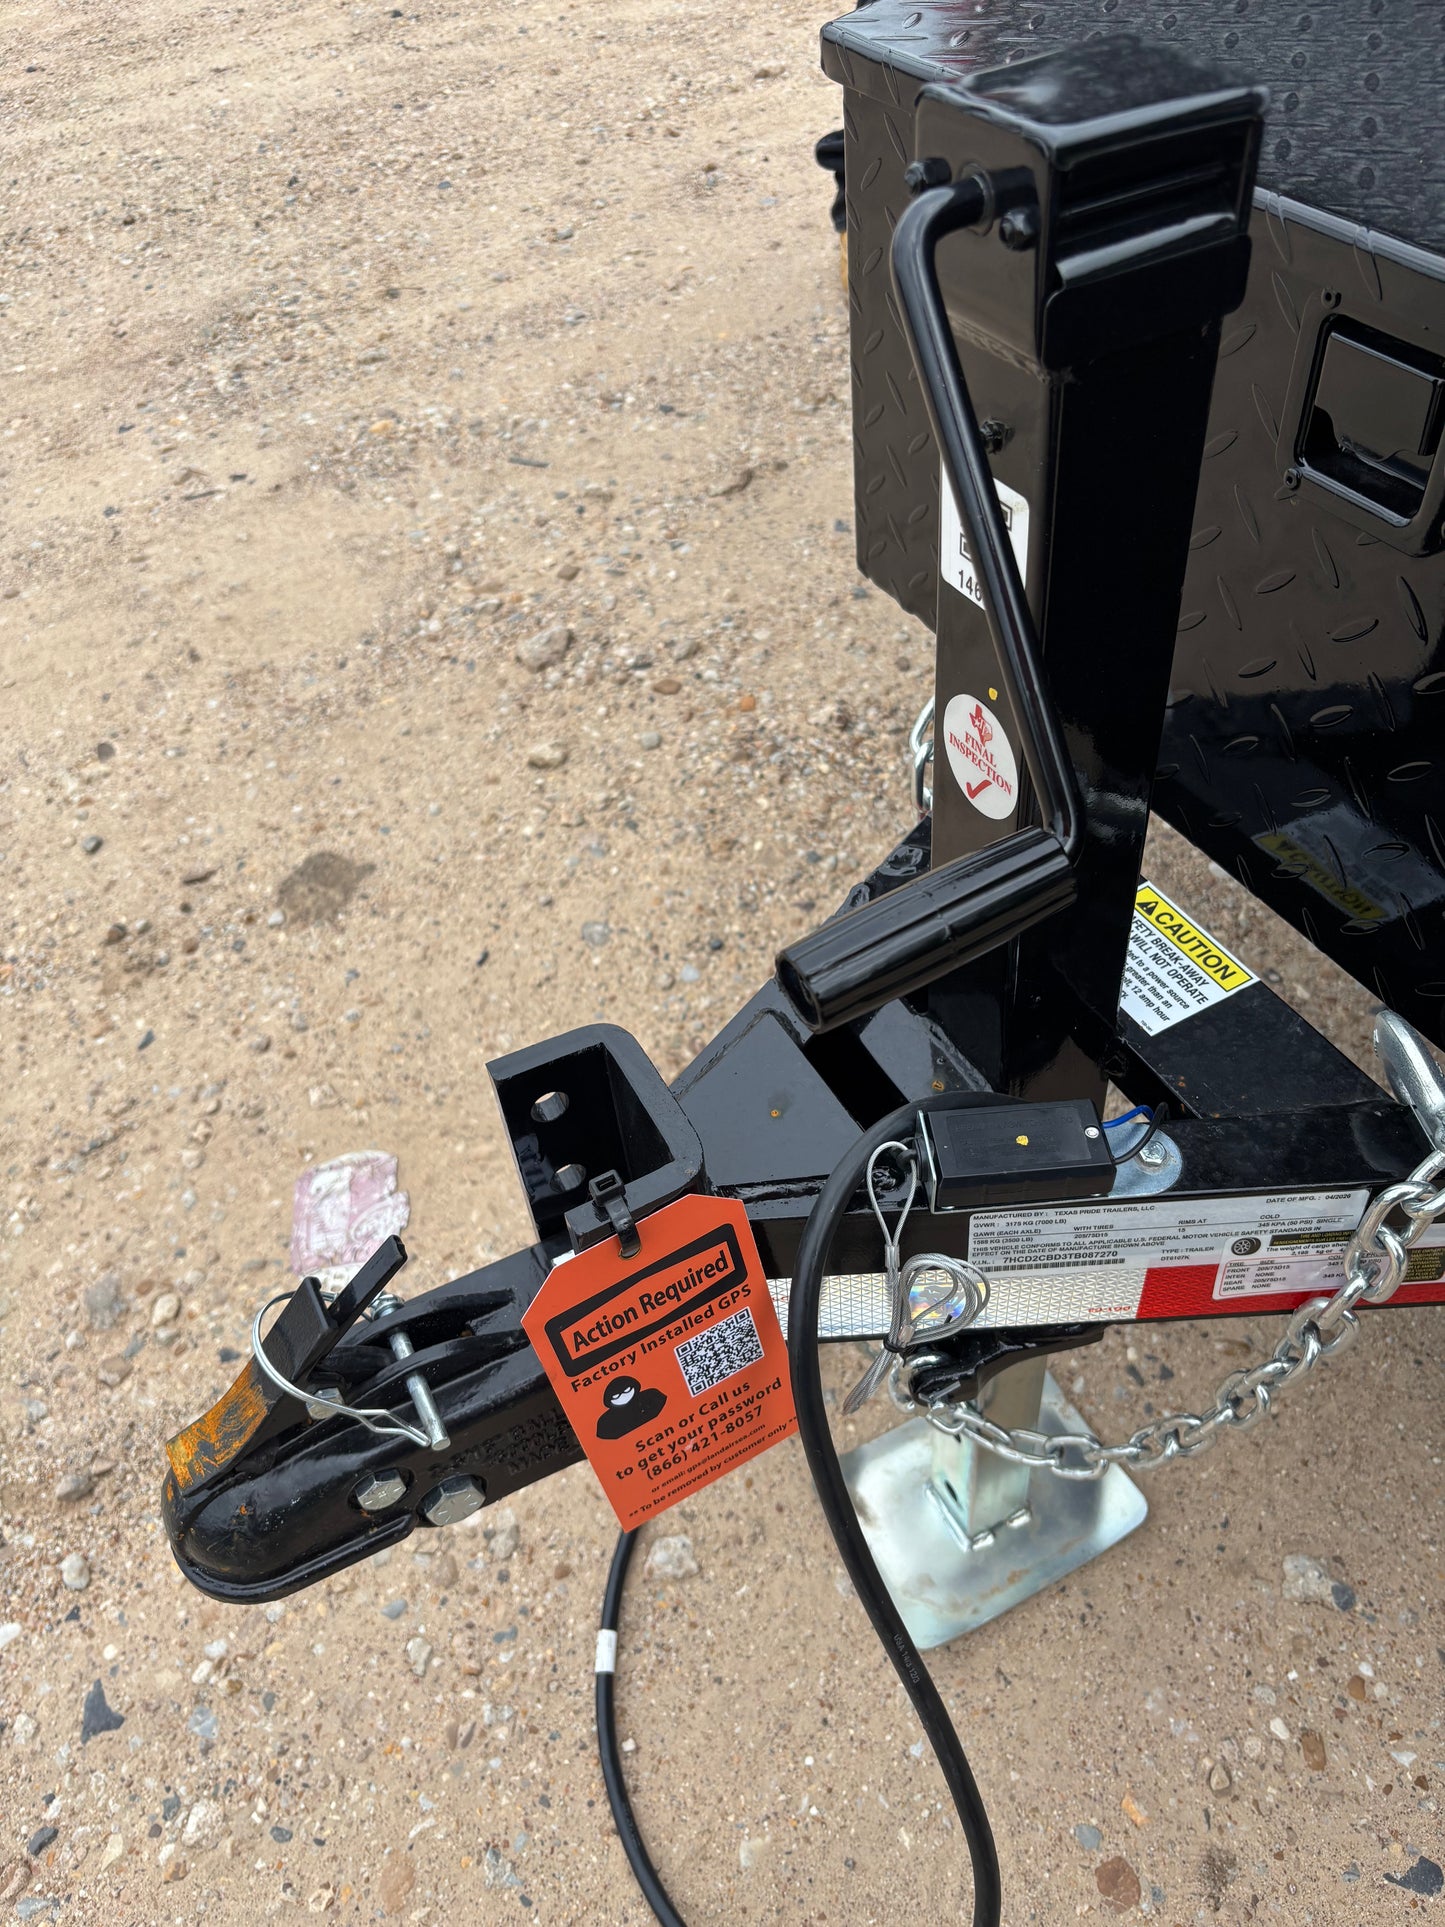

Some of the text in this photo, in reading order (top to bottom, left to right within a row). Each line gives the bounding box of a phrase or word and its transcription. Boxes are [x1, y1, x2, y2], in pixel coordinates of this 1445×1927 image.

[949, 732, 1012, 795] INSPECTION
[965, 731, 997, 768] FINAL
[1130, 934, 1153, 955] WILL
[1149, 952, 1172, 970] NOT
[1167, 969, 1209, 1005] OPERATE
[1151, 937, 1209, 987] BREAK-AWAY
[1155, 912, 1236, 981] CAUTION
[1125, 965, 1150, 987] greater
[1147, 985, 1164, 1001] than
[1161, 999, 1173, 1009] an
[1131, 985, 1143, 995] 12
[1139, 993, 1155, 1009] amp
[1153, 1006, 1171, 1022] hour
[1136, 959, 1145, 968] to
[1147, 970, 1169, 990] power
[1166, 987, 1190, 1010] source
[973, 1212, 1032, 1220] MANUFACTURED
[1021, 1241, 1061, 1249] CONFORMS
[1269, 1226, 1312, 1234] STANDARDS
[1059, 1244, 1112, 1252] MANUFACTURE
[572, 1249, 729, 1352] Action Required
[570, 1283, 752, 1393] Factory Installed GPS
[615, 1377, 783, 1481] to get your password
[635, 1382, 751, 1453] Scan or Call us
[646, 1405, 764, 1481] (866) 421-8057
[639, 1422, 788, 1513] To be removed by customer only
[651, 1485, 661, 1493] or
[686, 1423, 766, 1475] gps@landairsea.com
